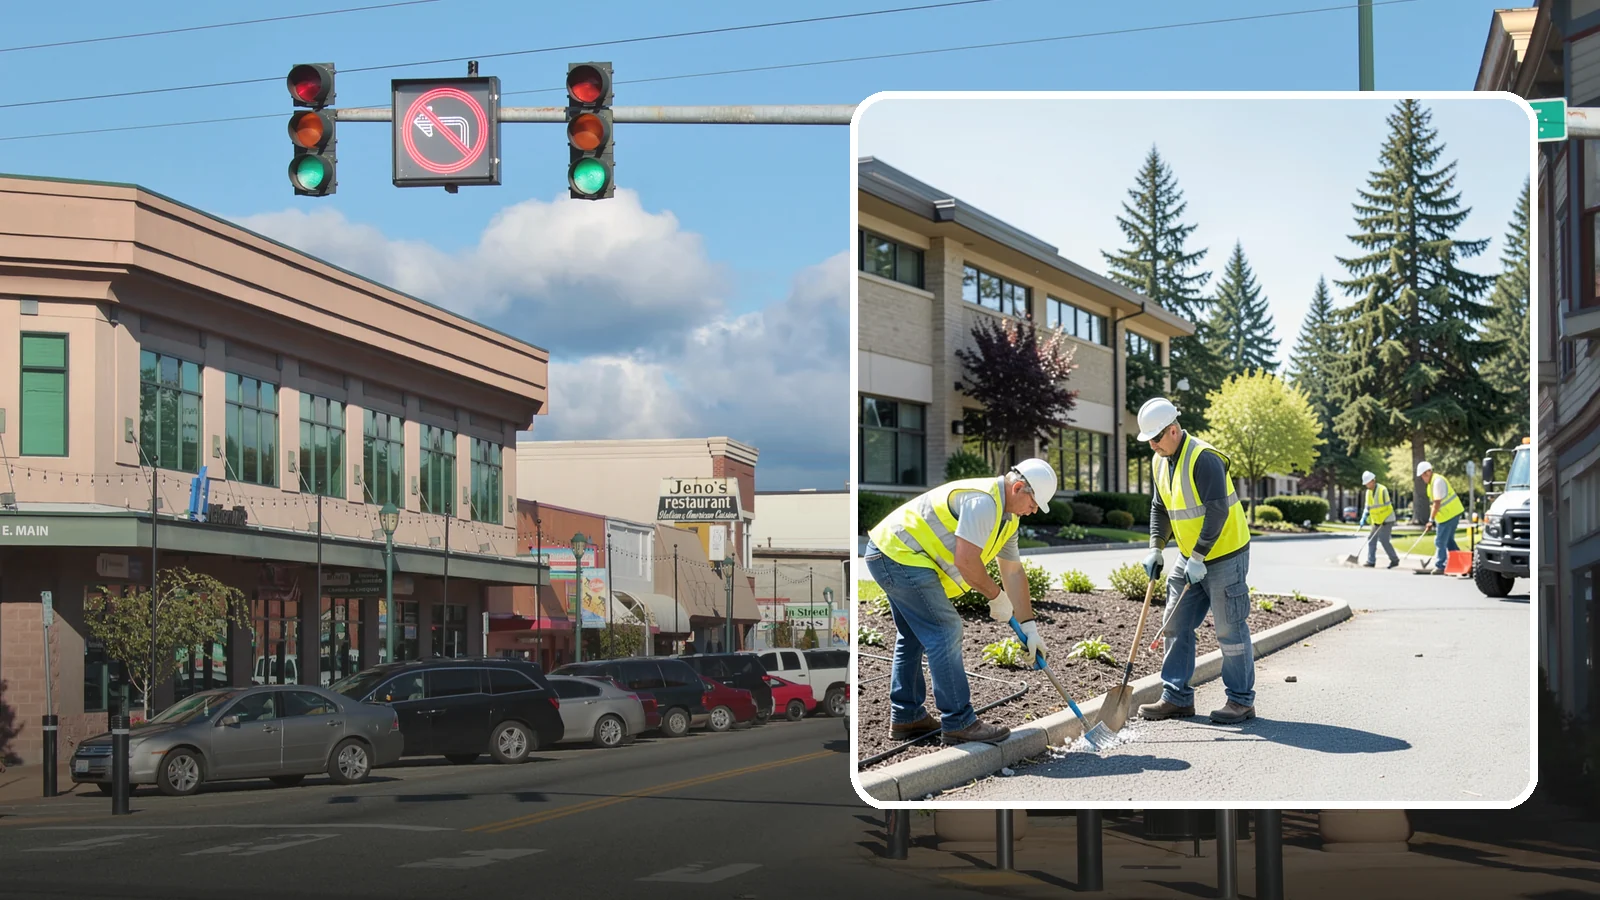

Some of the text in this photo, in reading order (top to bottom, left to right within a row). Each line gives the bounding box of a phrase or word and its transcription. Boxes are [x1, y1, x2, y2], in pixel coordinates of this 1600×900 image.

[670, 480, 727, 494] Jeno's
[665, 496, 731, 509] restaurant
[658, 510, 681, 519] Italian
[686, 510, 714, 519] American
[715, 509, 737, 519] Cuisine
[2, 525, 49, 536] E. MAIN
[797, 608, 828, 617] Street
